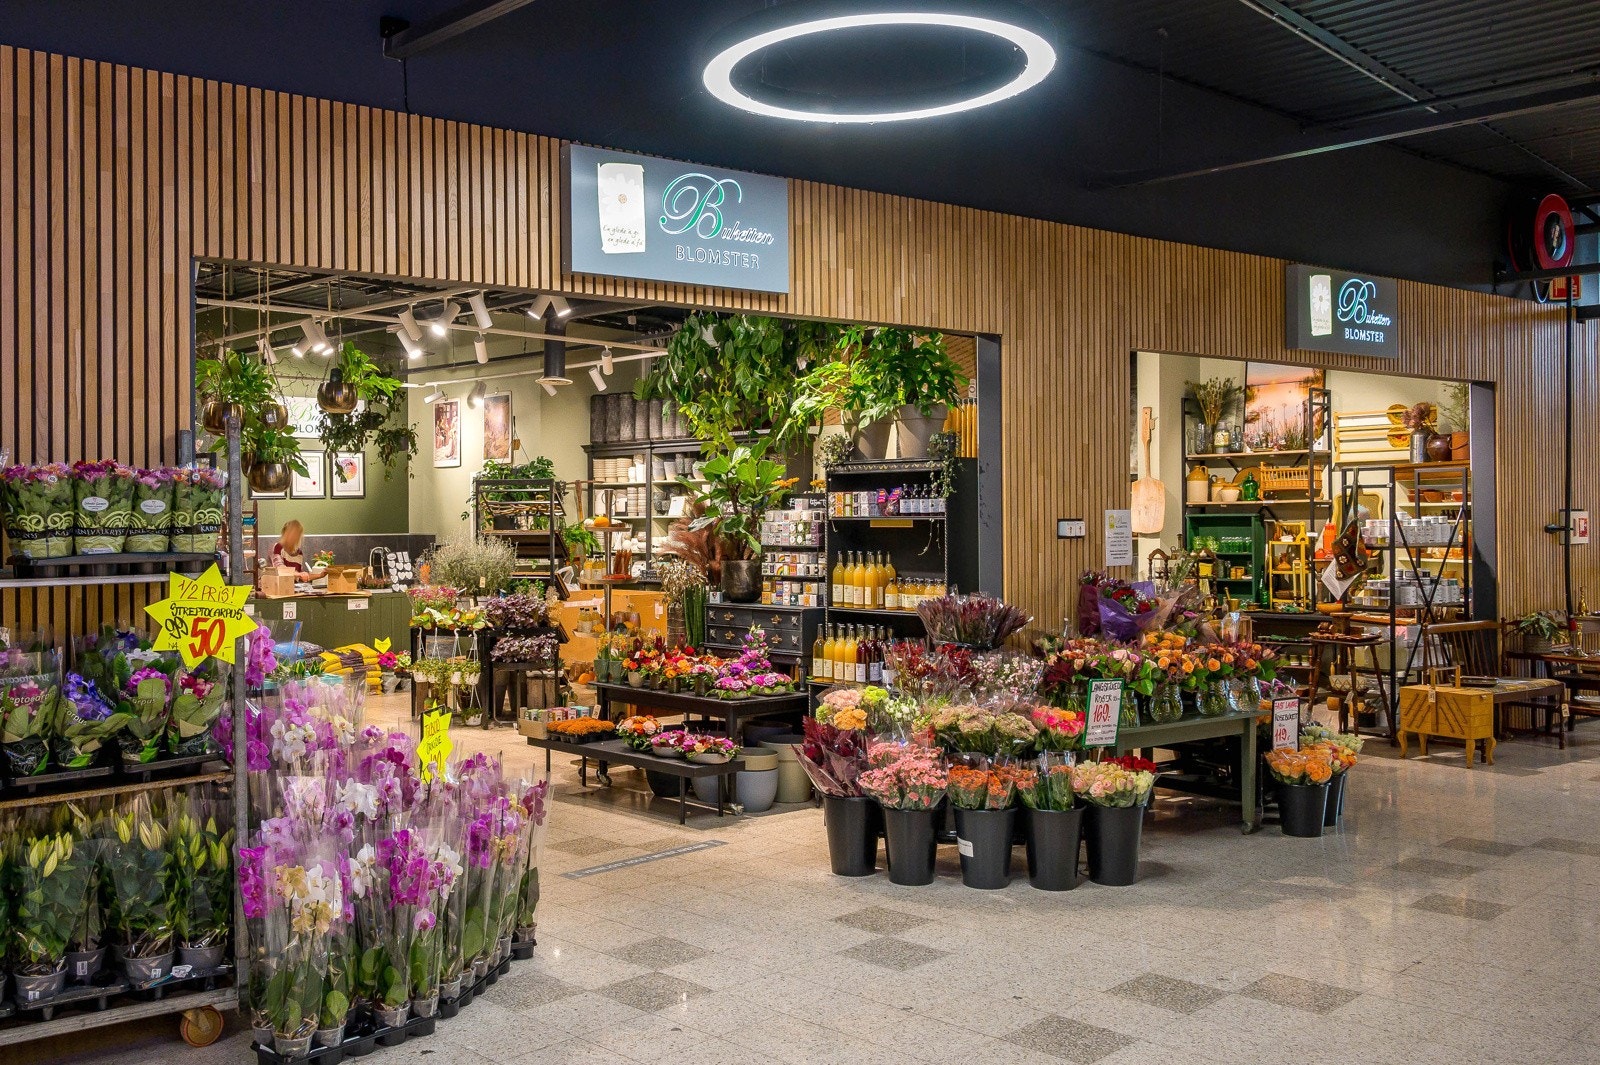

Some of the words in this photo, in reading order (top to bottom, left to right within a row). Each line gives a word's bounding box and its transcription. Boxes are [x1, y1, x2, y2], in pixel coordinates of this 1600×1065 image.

[675, 244, 760, 270] BLOMSTER
[1344, 327, 1384, 343] BLOMSTER
[178, 579, 198, 600] 1/2
[169, 602, 244, 621] STREPTOCARPUS
[285, 610, 294, 619] 70
[164, 616, 189, 640] 99
